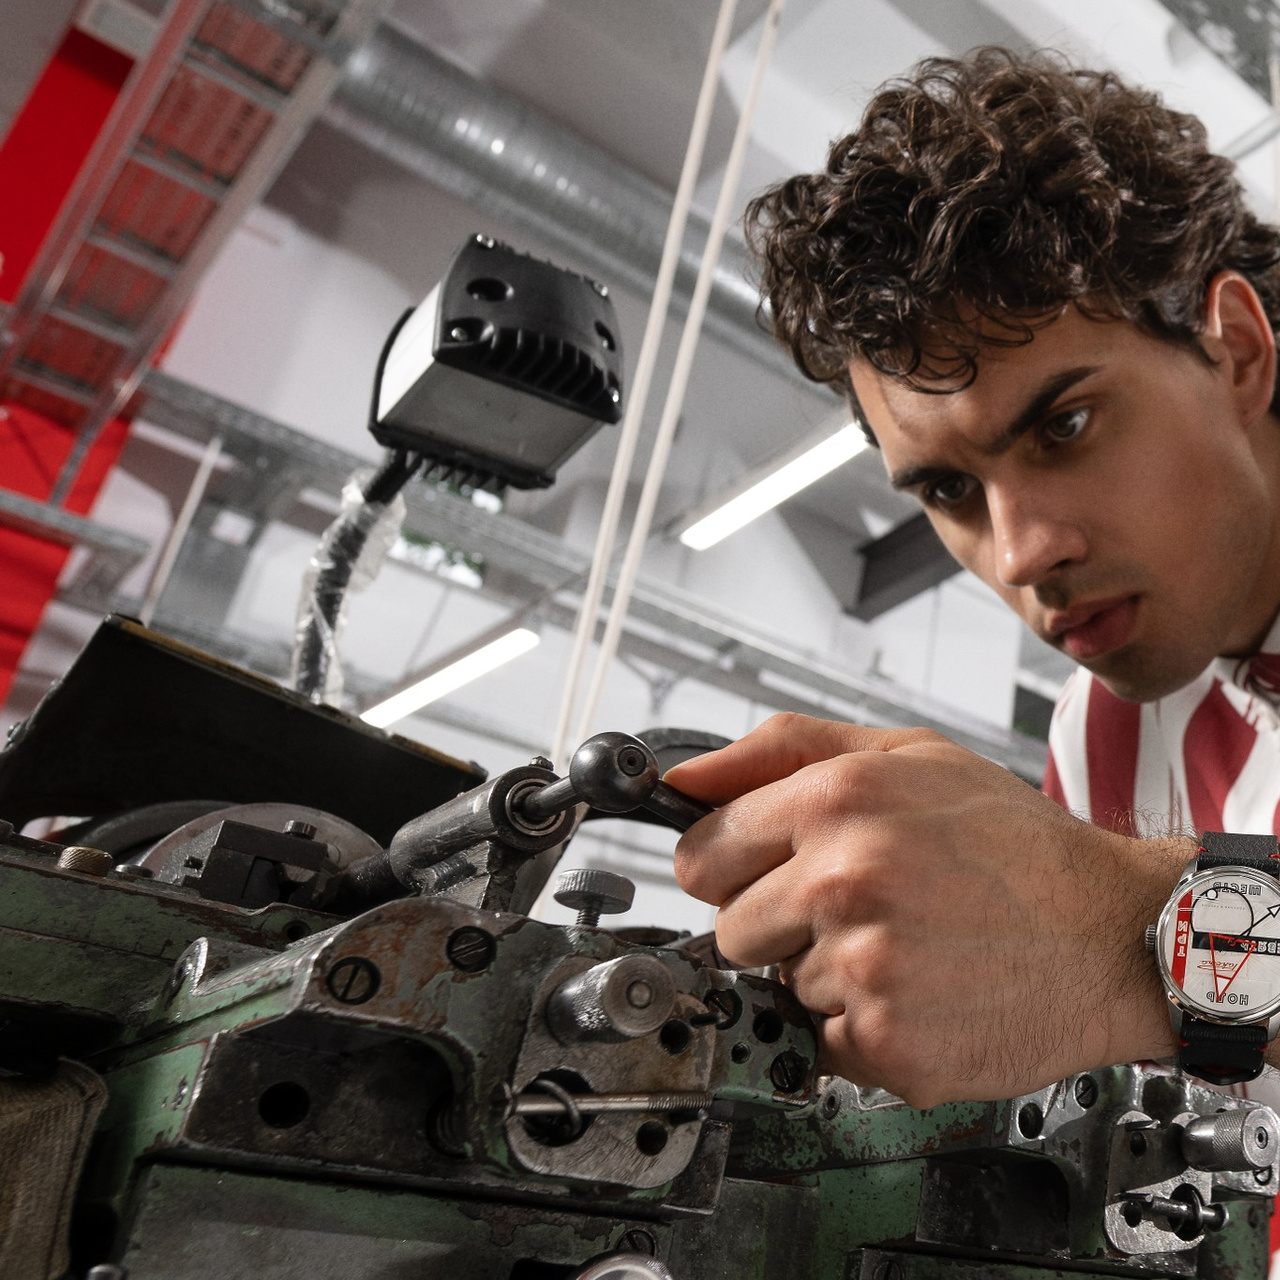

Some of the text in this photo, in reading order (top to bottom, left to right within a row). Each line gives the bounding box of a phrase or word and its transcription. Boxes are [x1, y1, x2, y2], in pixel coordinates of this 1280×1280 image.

[1212, 882, 1262, 896] ШЕСТЬ
[1177, 920, 1189, 957] ТРИ
[1206, 991, 1249, 1006] НОЛЬ
